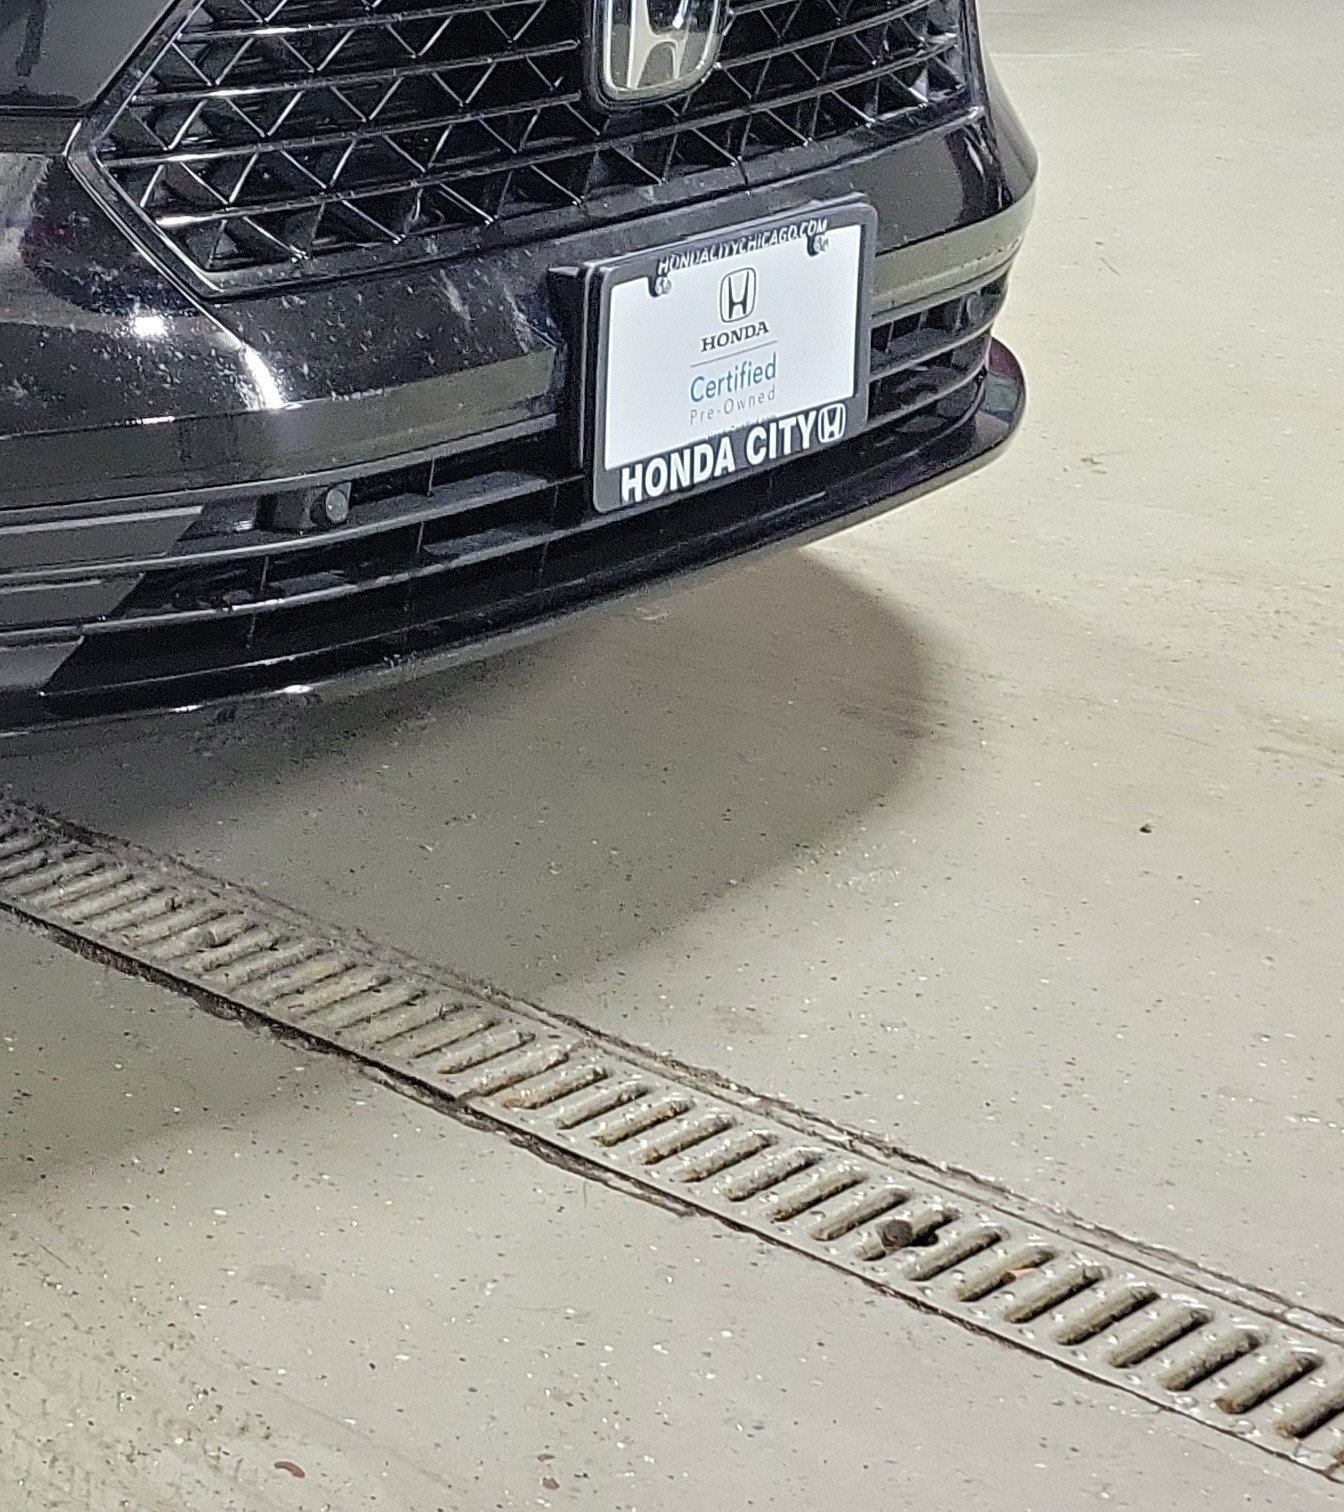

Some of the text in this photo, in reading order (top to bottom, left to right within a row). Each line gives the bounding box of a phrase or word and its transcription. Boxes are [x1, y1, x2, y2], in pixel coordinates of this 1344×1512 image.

[700, 321, 769, 352] HONDA
[691, 352, 776, 402] Certified
[691, 383, 776, 426] Pre-Owned
[621, 436, 736, 502] HONDA
[746, 410, 817, 466] CITY
